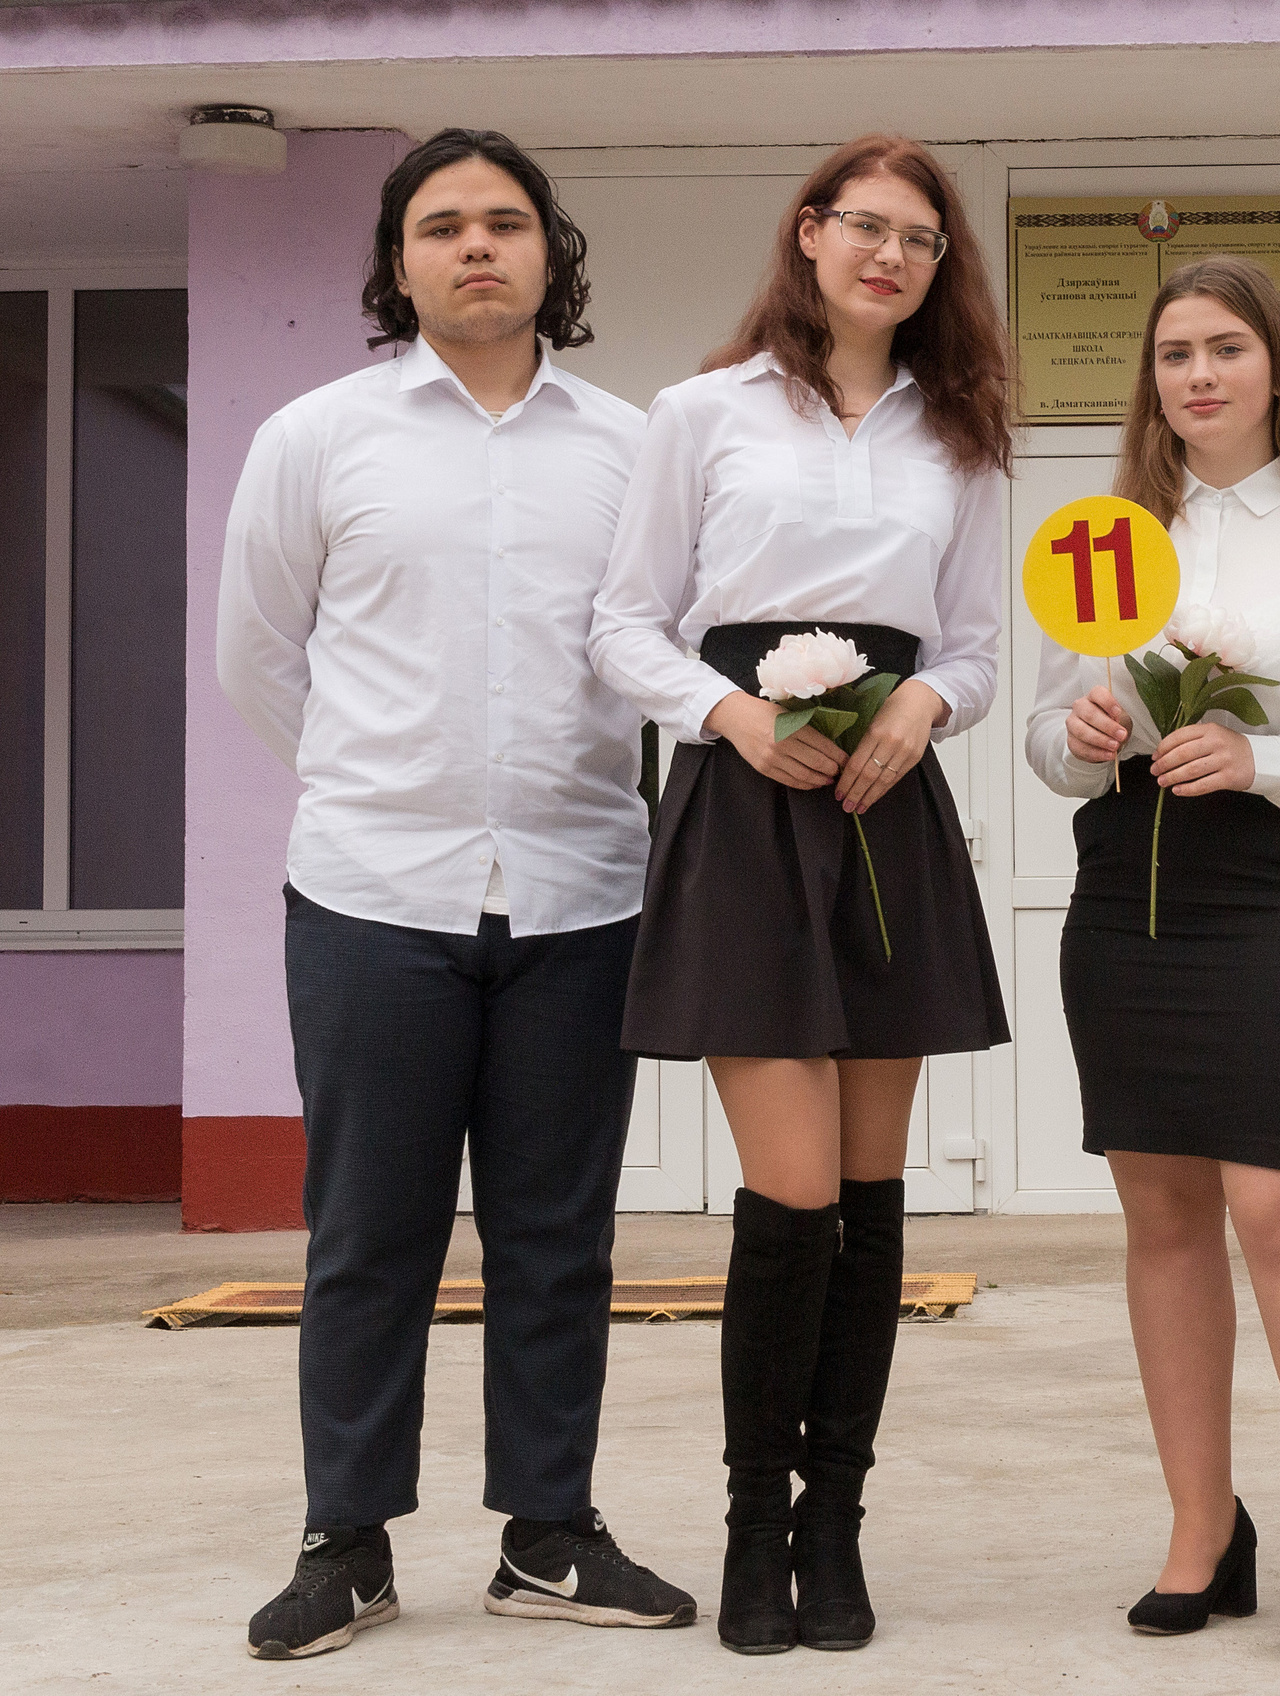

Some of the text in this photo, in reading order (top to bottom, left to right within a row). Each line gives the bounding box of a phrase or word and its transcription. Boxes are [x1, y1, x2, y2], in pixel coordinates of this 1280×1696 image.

[1057, 277, 1120, 289] Дзяржаўная
[1040, 290, 1137, 303] ўстанова адукацыі
[1072, 344, 1104, 353] ШКОЛА
[1051, 357, 1095, 366] КЛЕЦКАГА
[1051, 516, 1138, 623] 11
